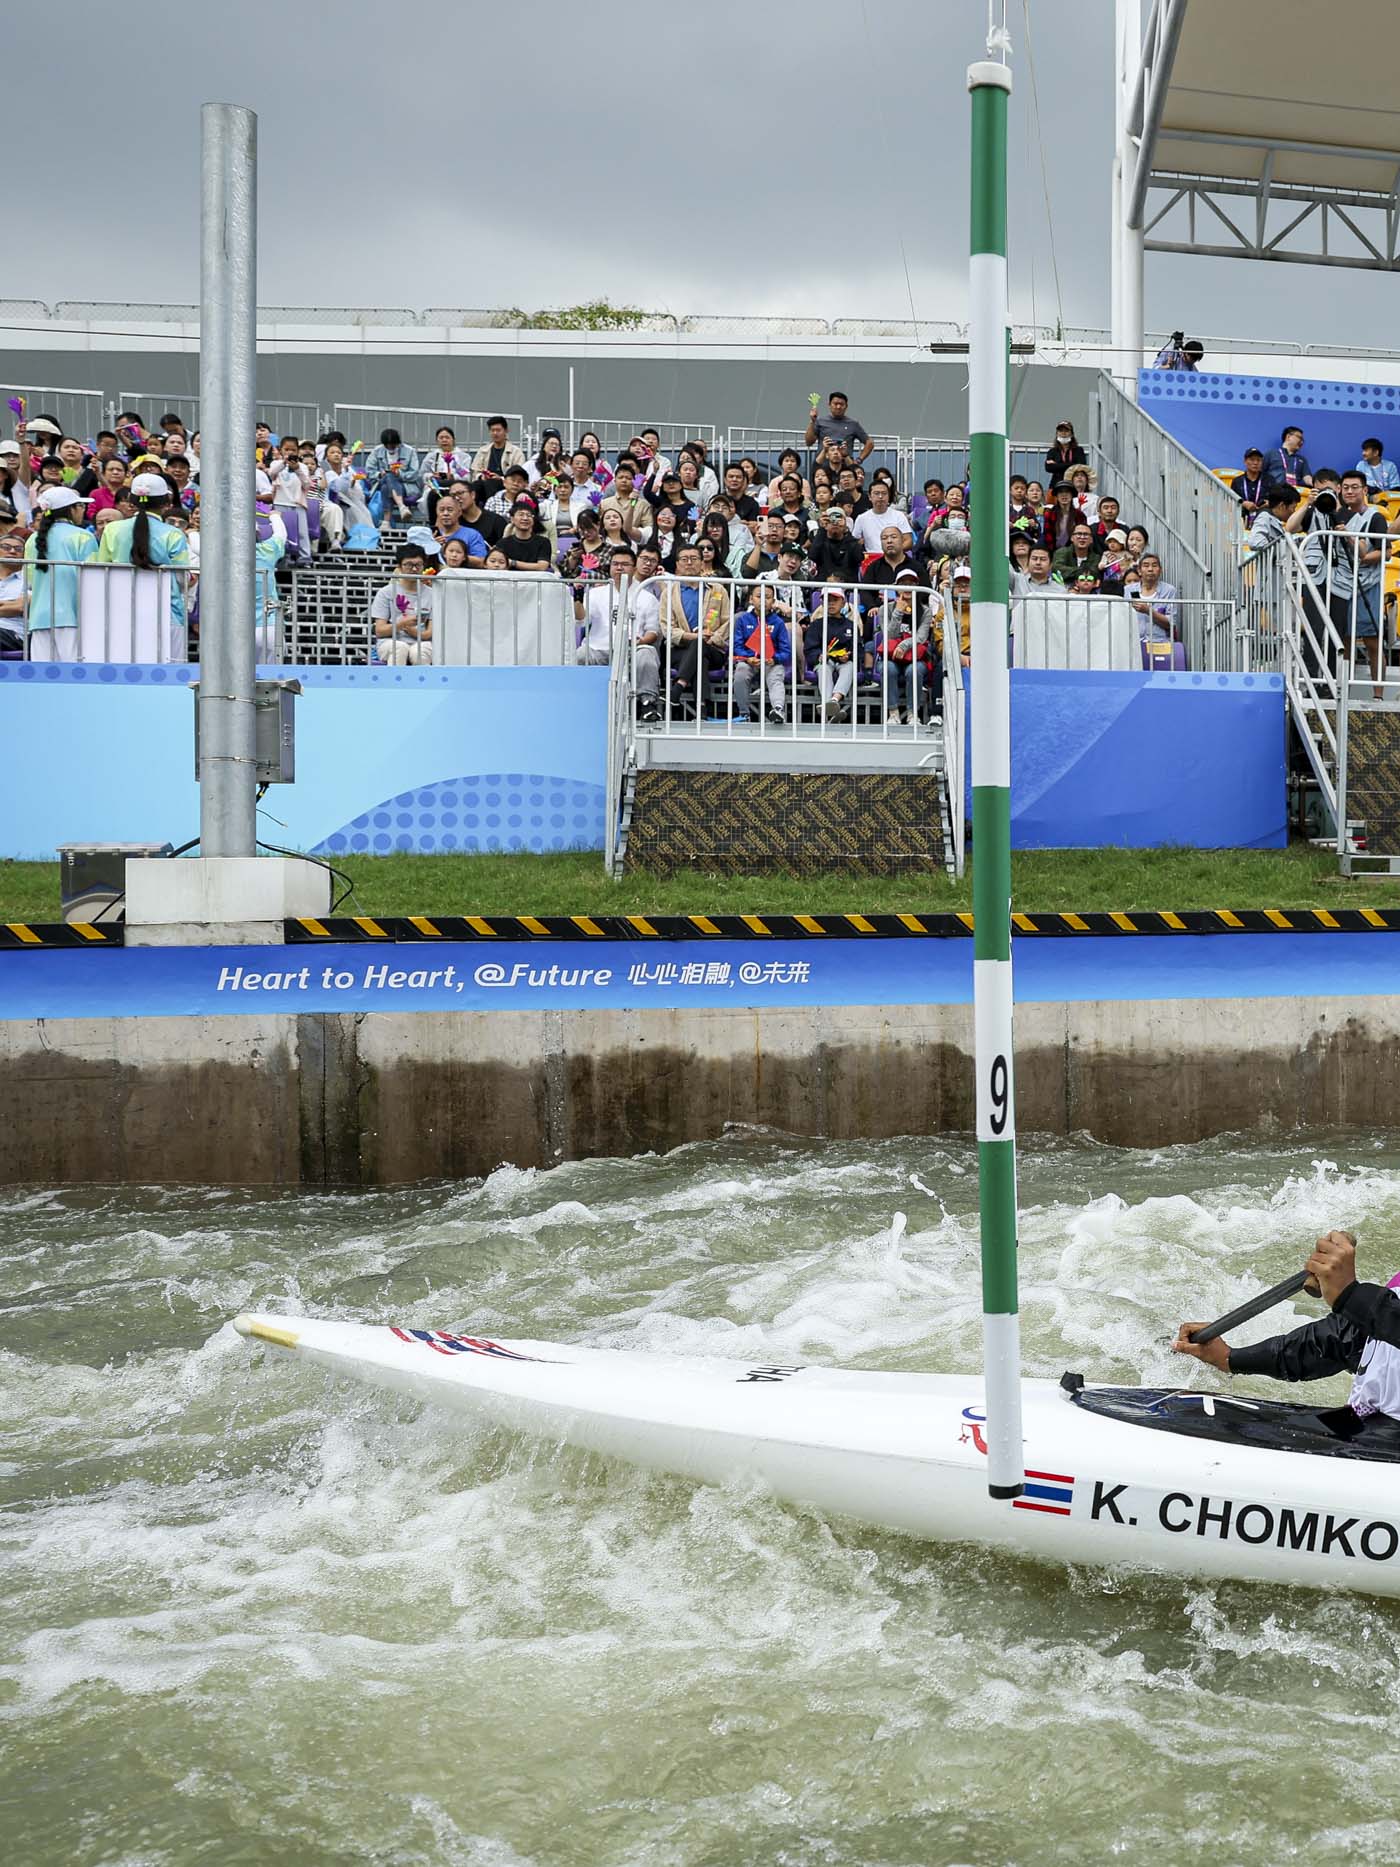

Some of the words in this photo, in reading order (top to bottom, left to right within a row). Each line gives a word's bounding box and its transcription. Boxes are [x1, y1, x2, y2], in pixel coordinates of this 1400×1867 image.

[216, 967, 310, 990] Heart
[322, 968, 354, 989] to
[363, 965, 464, 992] Heart,
[473, 963, 612, 987] @Future
[990, 1054, 1008, 1135] 9
[736, 1364, 807, 1382] THA
[1090, 1480, 1138, 1526] K.
